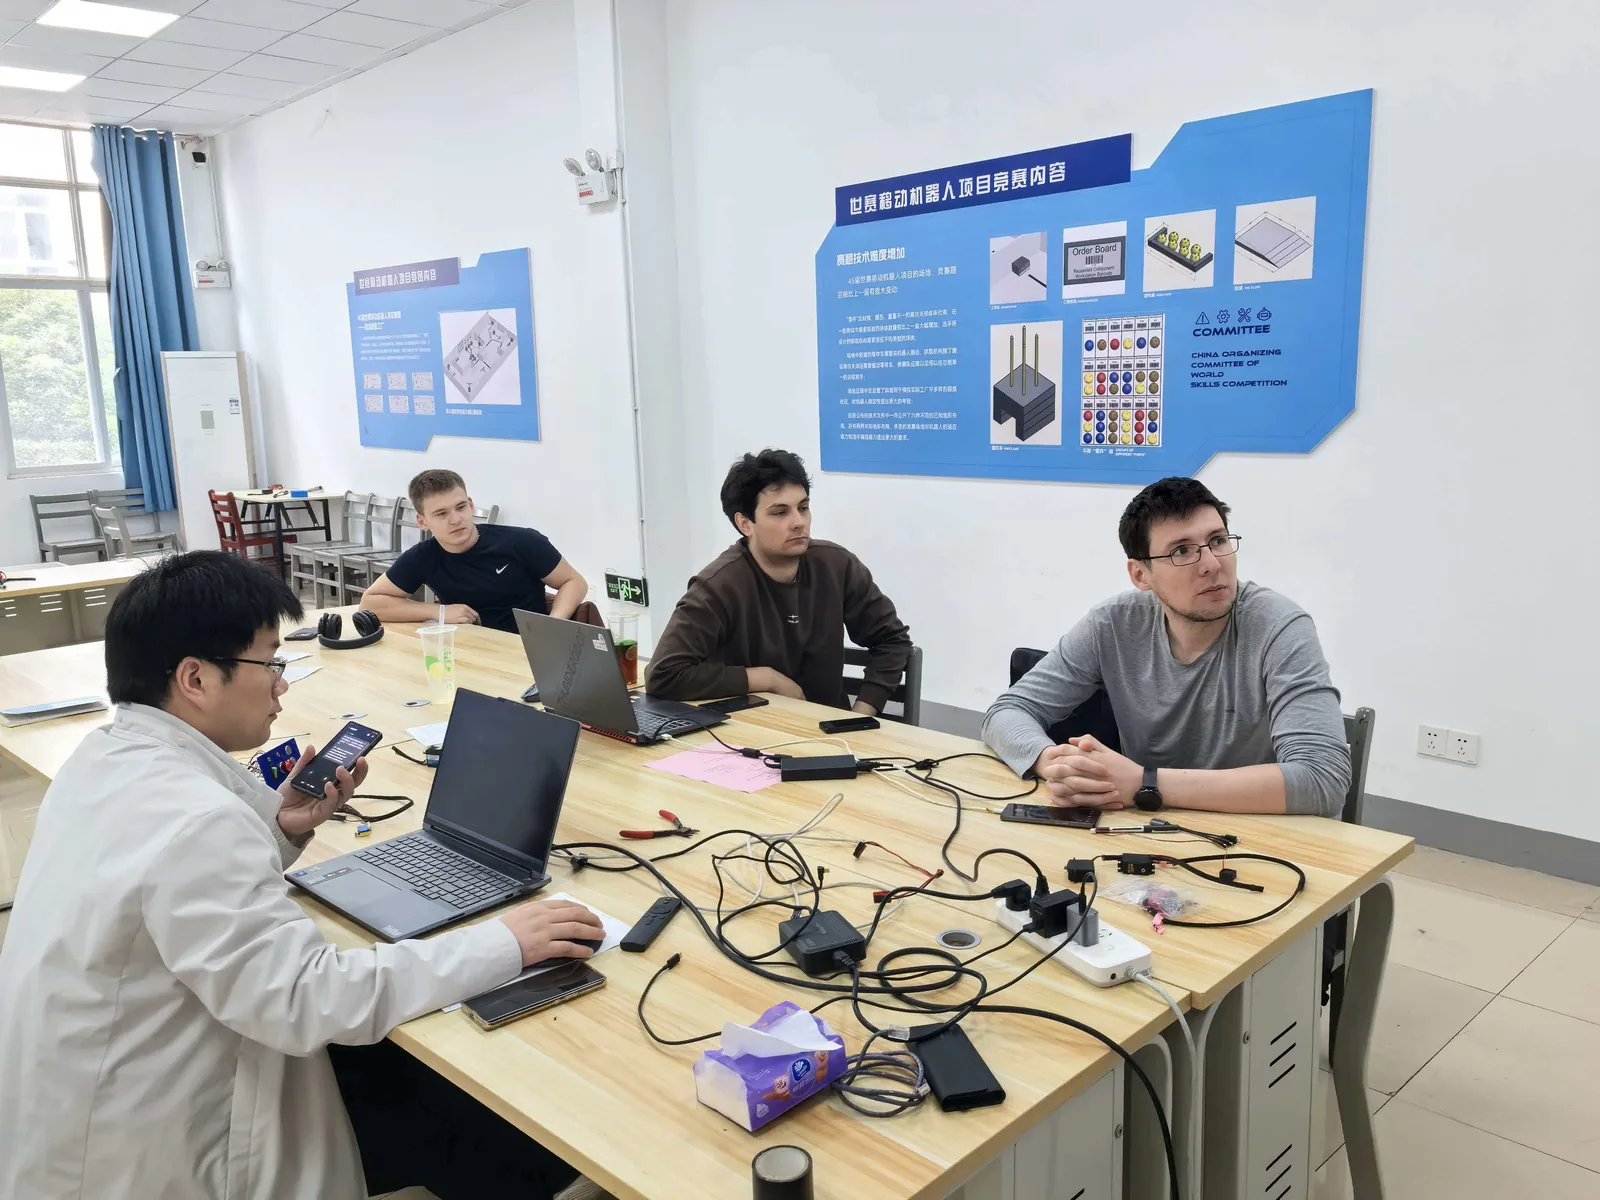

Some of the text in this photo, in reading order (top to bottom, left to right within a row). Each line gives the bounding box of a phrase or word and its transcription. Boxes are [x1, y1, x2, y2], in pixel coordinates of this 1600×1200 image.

[850, 161, 1066, 215] 世赛移动机器人项目竞赛内容
[1072, 244, 1117, 256] Order Board
[836, 247, 905, 266] 赛题技术难度增加
[1192, 324, 1271, 337] COMMITTEE
[1191, 349, 1282, 359] CHINA ORGANIZING
[1191, 360, 1244, 369] COMMITTEE
[1222, 379, 1288, 388] COMPETITION
